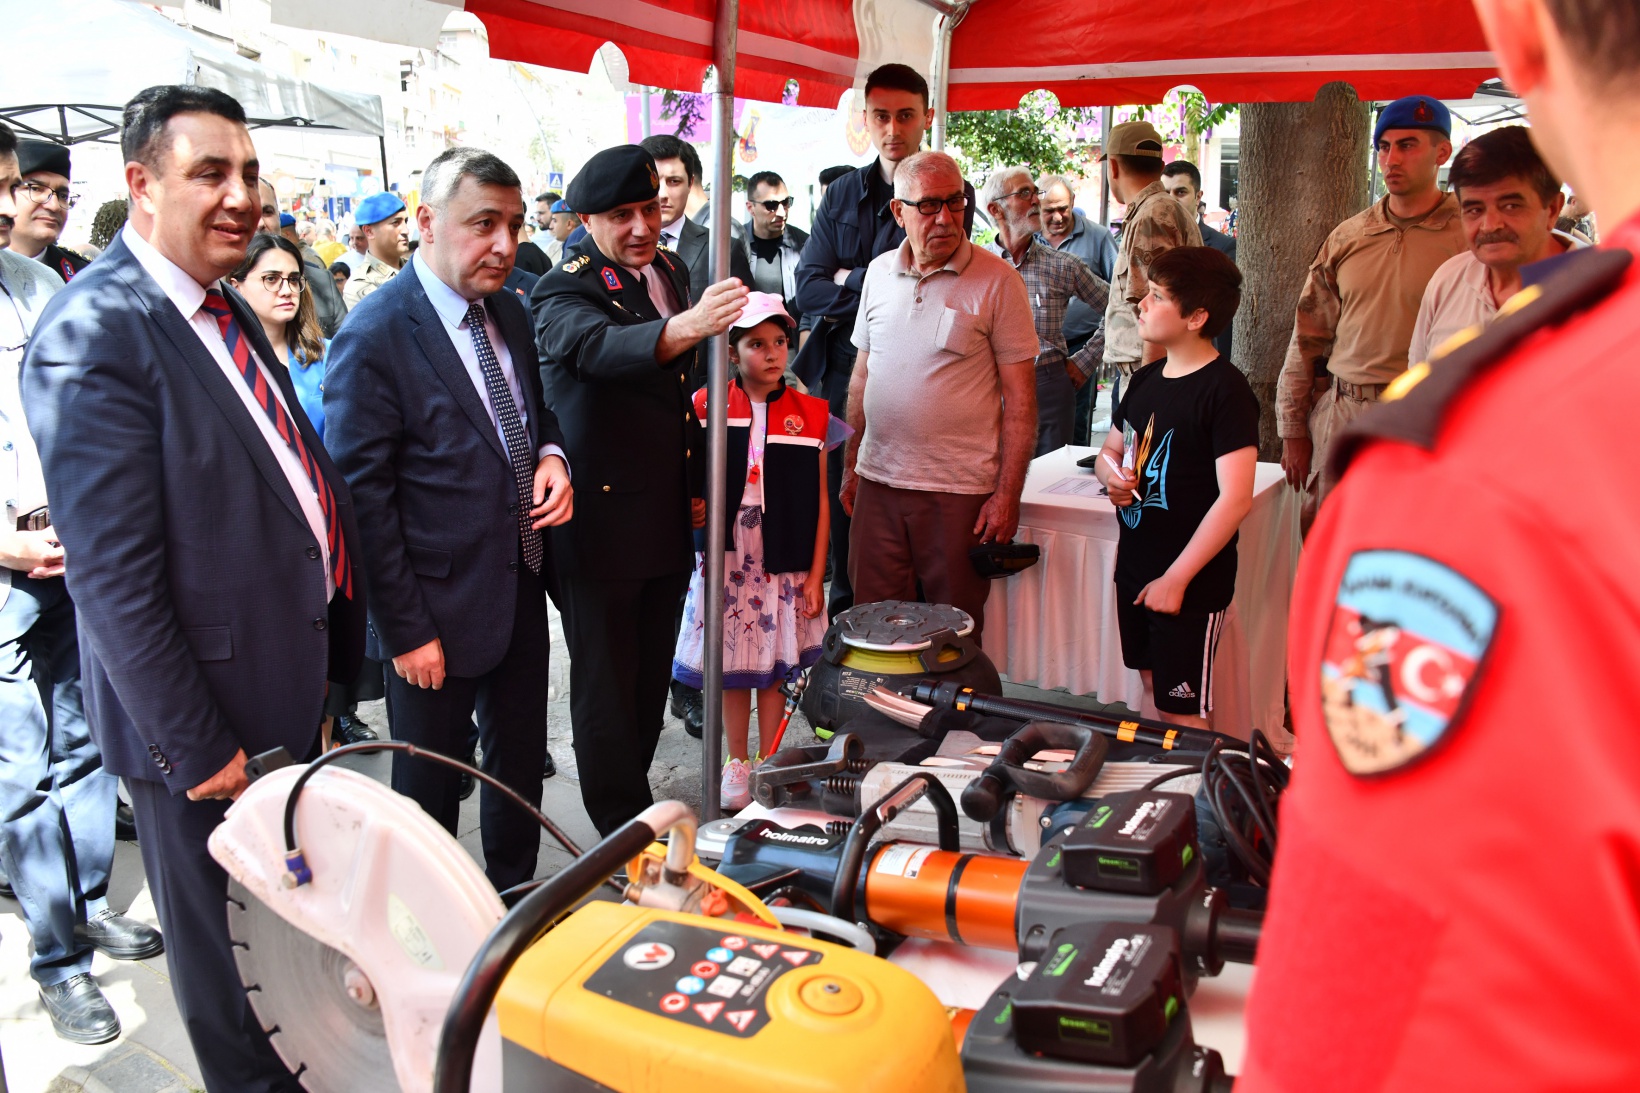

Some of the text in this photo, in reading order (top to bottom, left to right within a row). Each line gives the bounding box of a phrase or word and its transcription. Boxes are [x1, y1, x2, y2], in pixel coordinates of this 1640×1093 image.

[1168, 690, 1196, 698] adidas
[1118, 801, 1155, 835] holmatro
[760, 828, 829, 846] holmatro
[1084, 938, 1130, 987] holmatro
